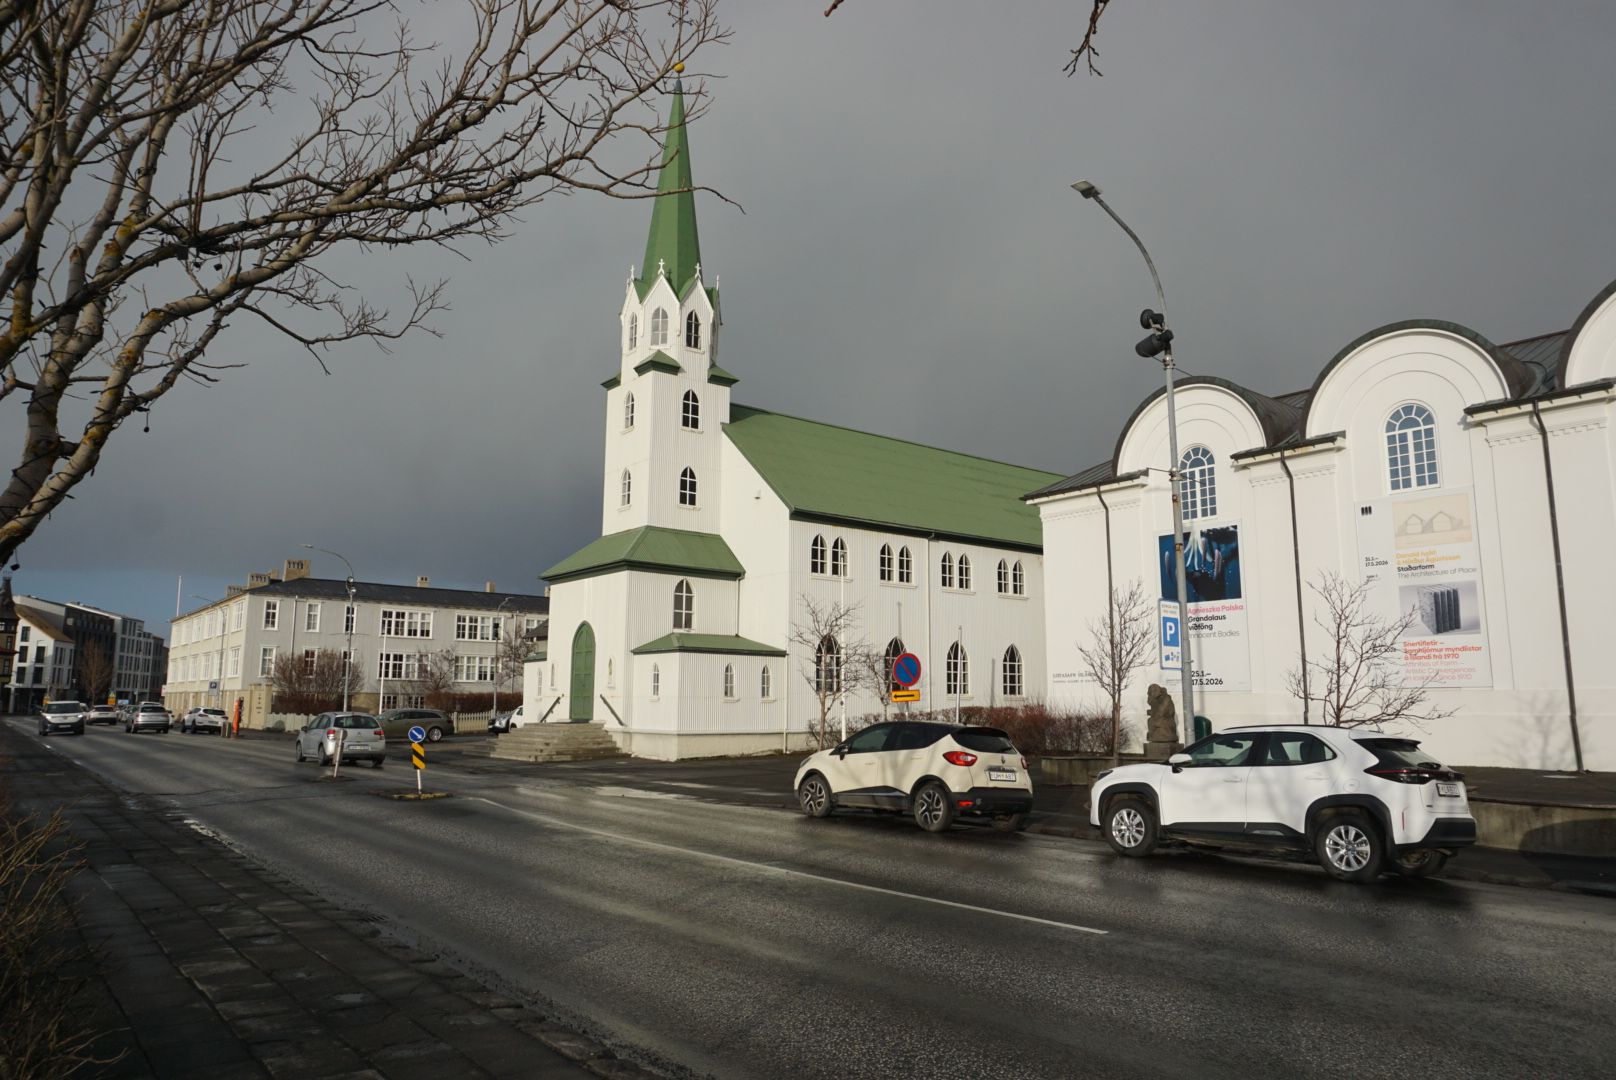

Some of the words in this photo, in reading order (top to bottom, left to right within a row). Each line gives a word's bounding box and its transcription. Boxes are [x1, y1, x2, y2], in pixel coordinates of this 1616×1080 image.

[1397, 564, 1435, 573] Staðarform
[1188, 614, 1226, 622] Grandalaus
[1166, 621, 1175, 641] P
